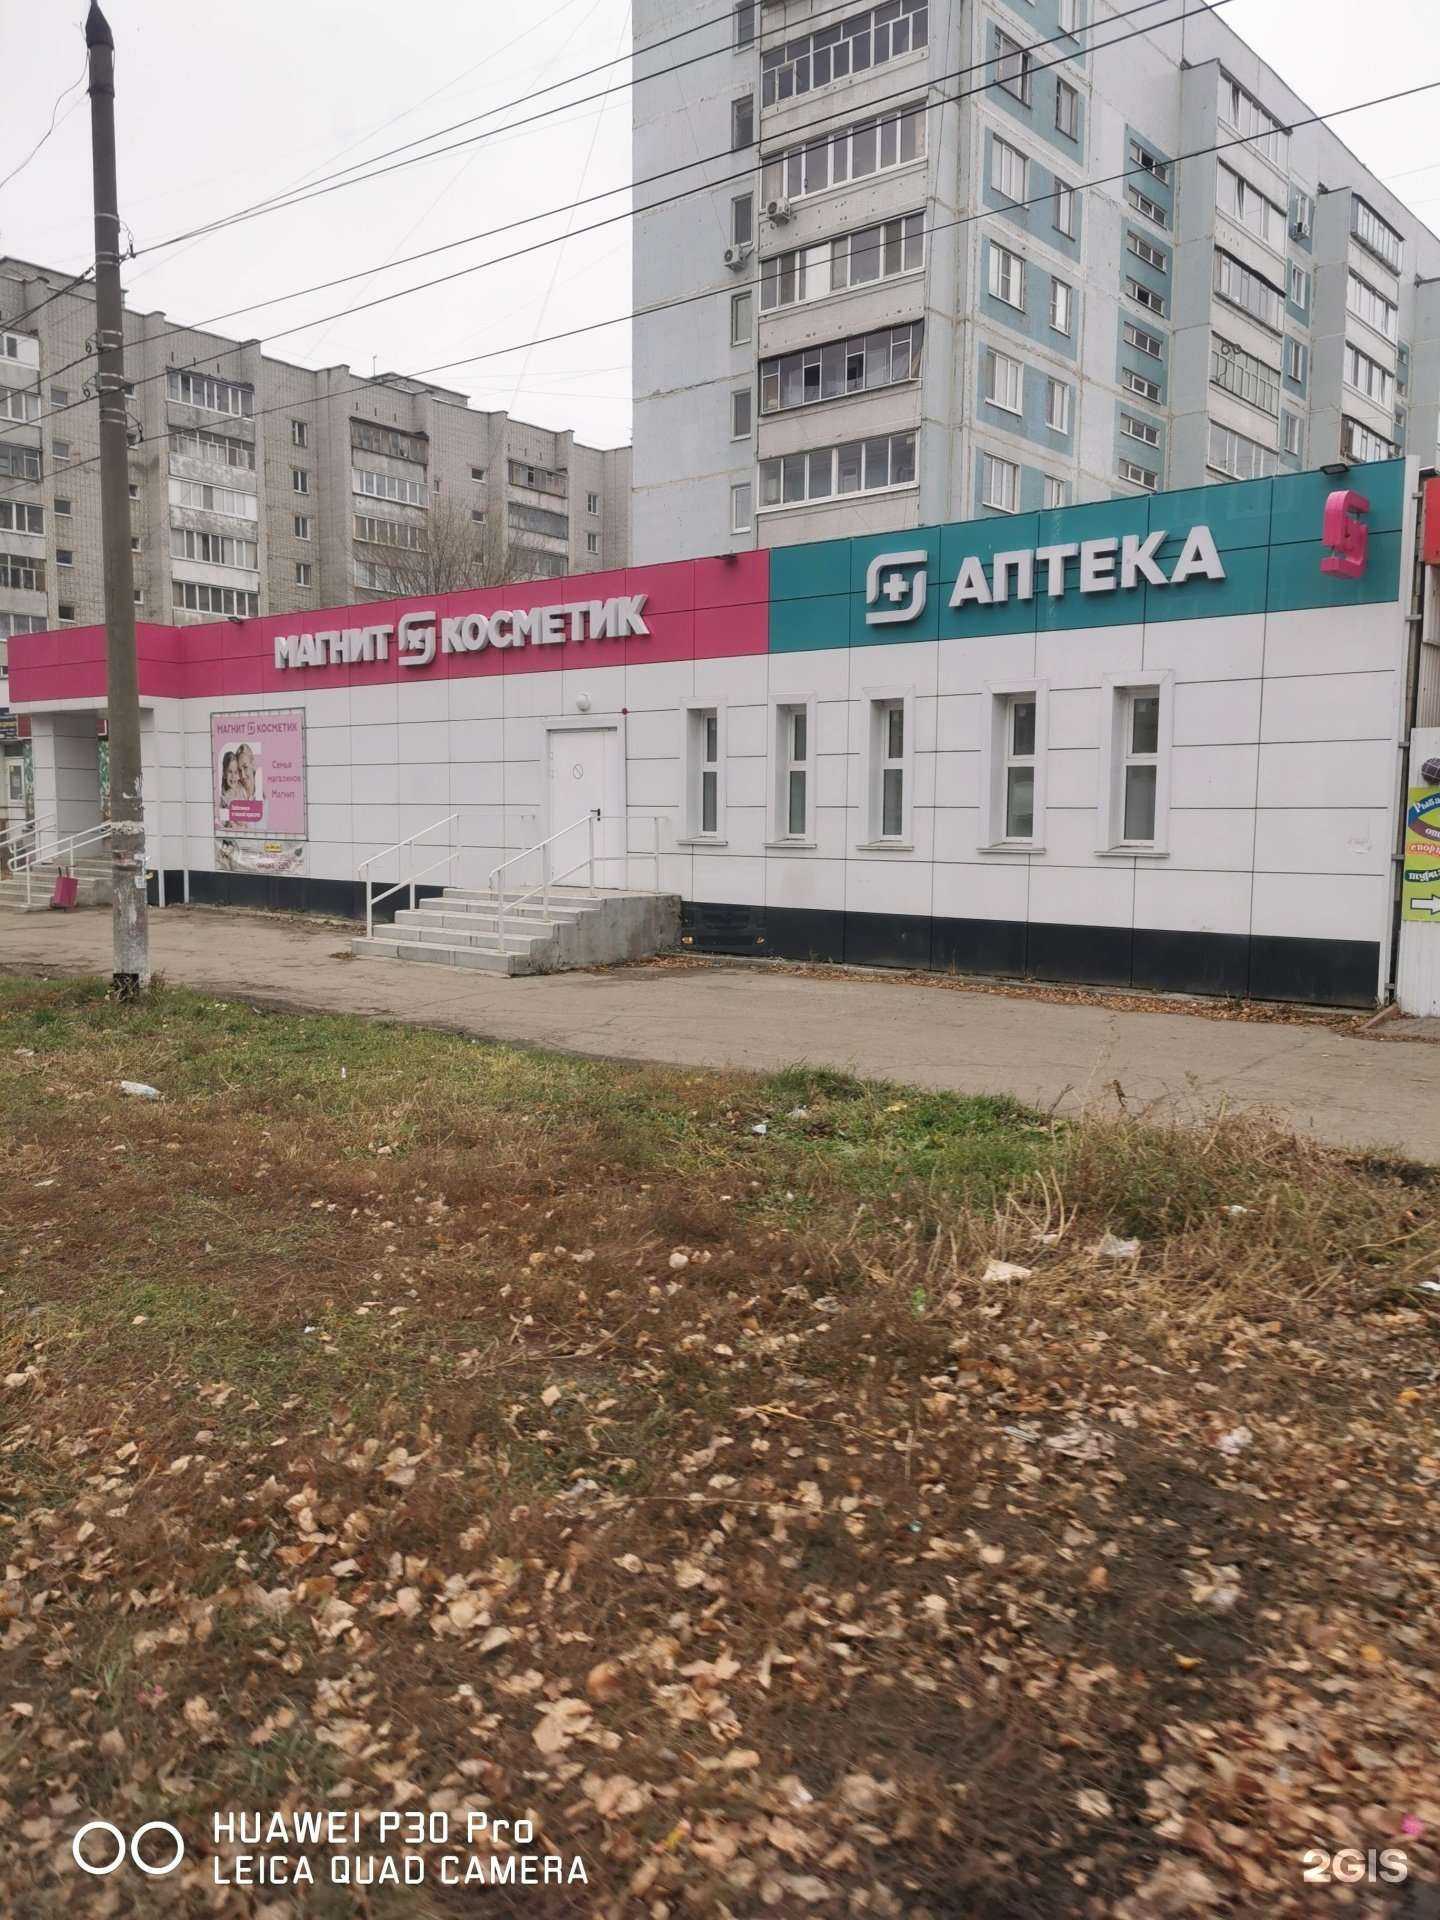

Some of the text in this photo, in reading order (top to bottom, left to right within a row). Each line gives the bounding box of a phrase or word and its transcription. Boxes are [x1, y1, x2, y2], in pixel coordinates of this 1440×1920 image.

[949, 525, 1226, 608] АПТЕКА
[274, 594, 650, 670] МАГНИТ КОСМЕТИК
[217, 721, 298, 735] МАГНИТ КОСМЕТИК
